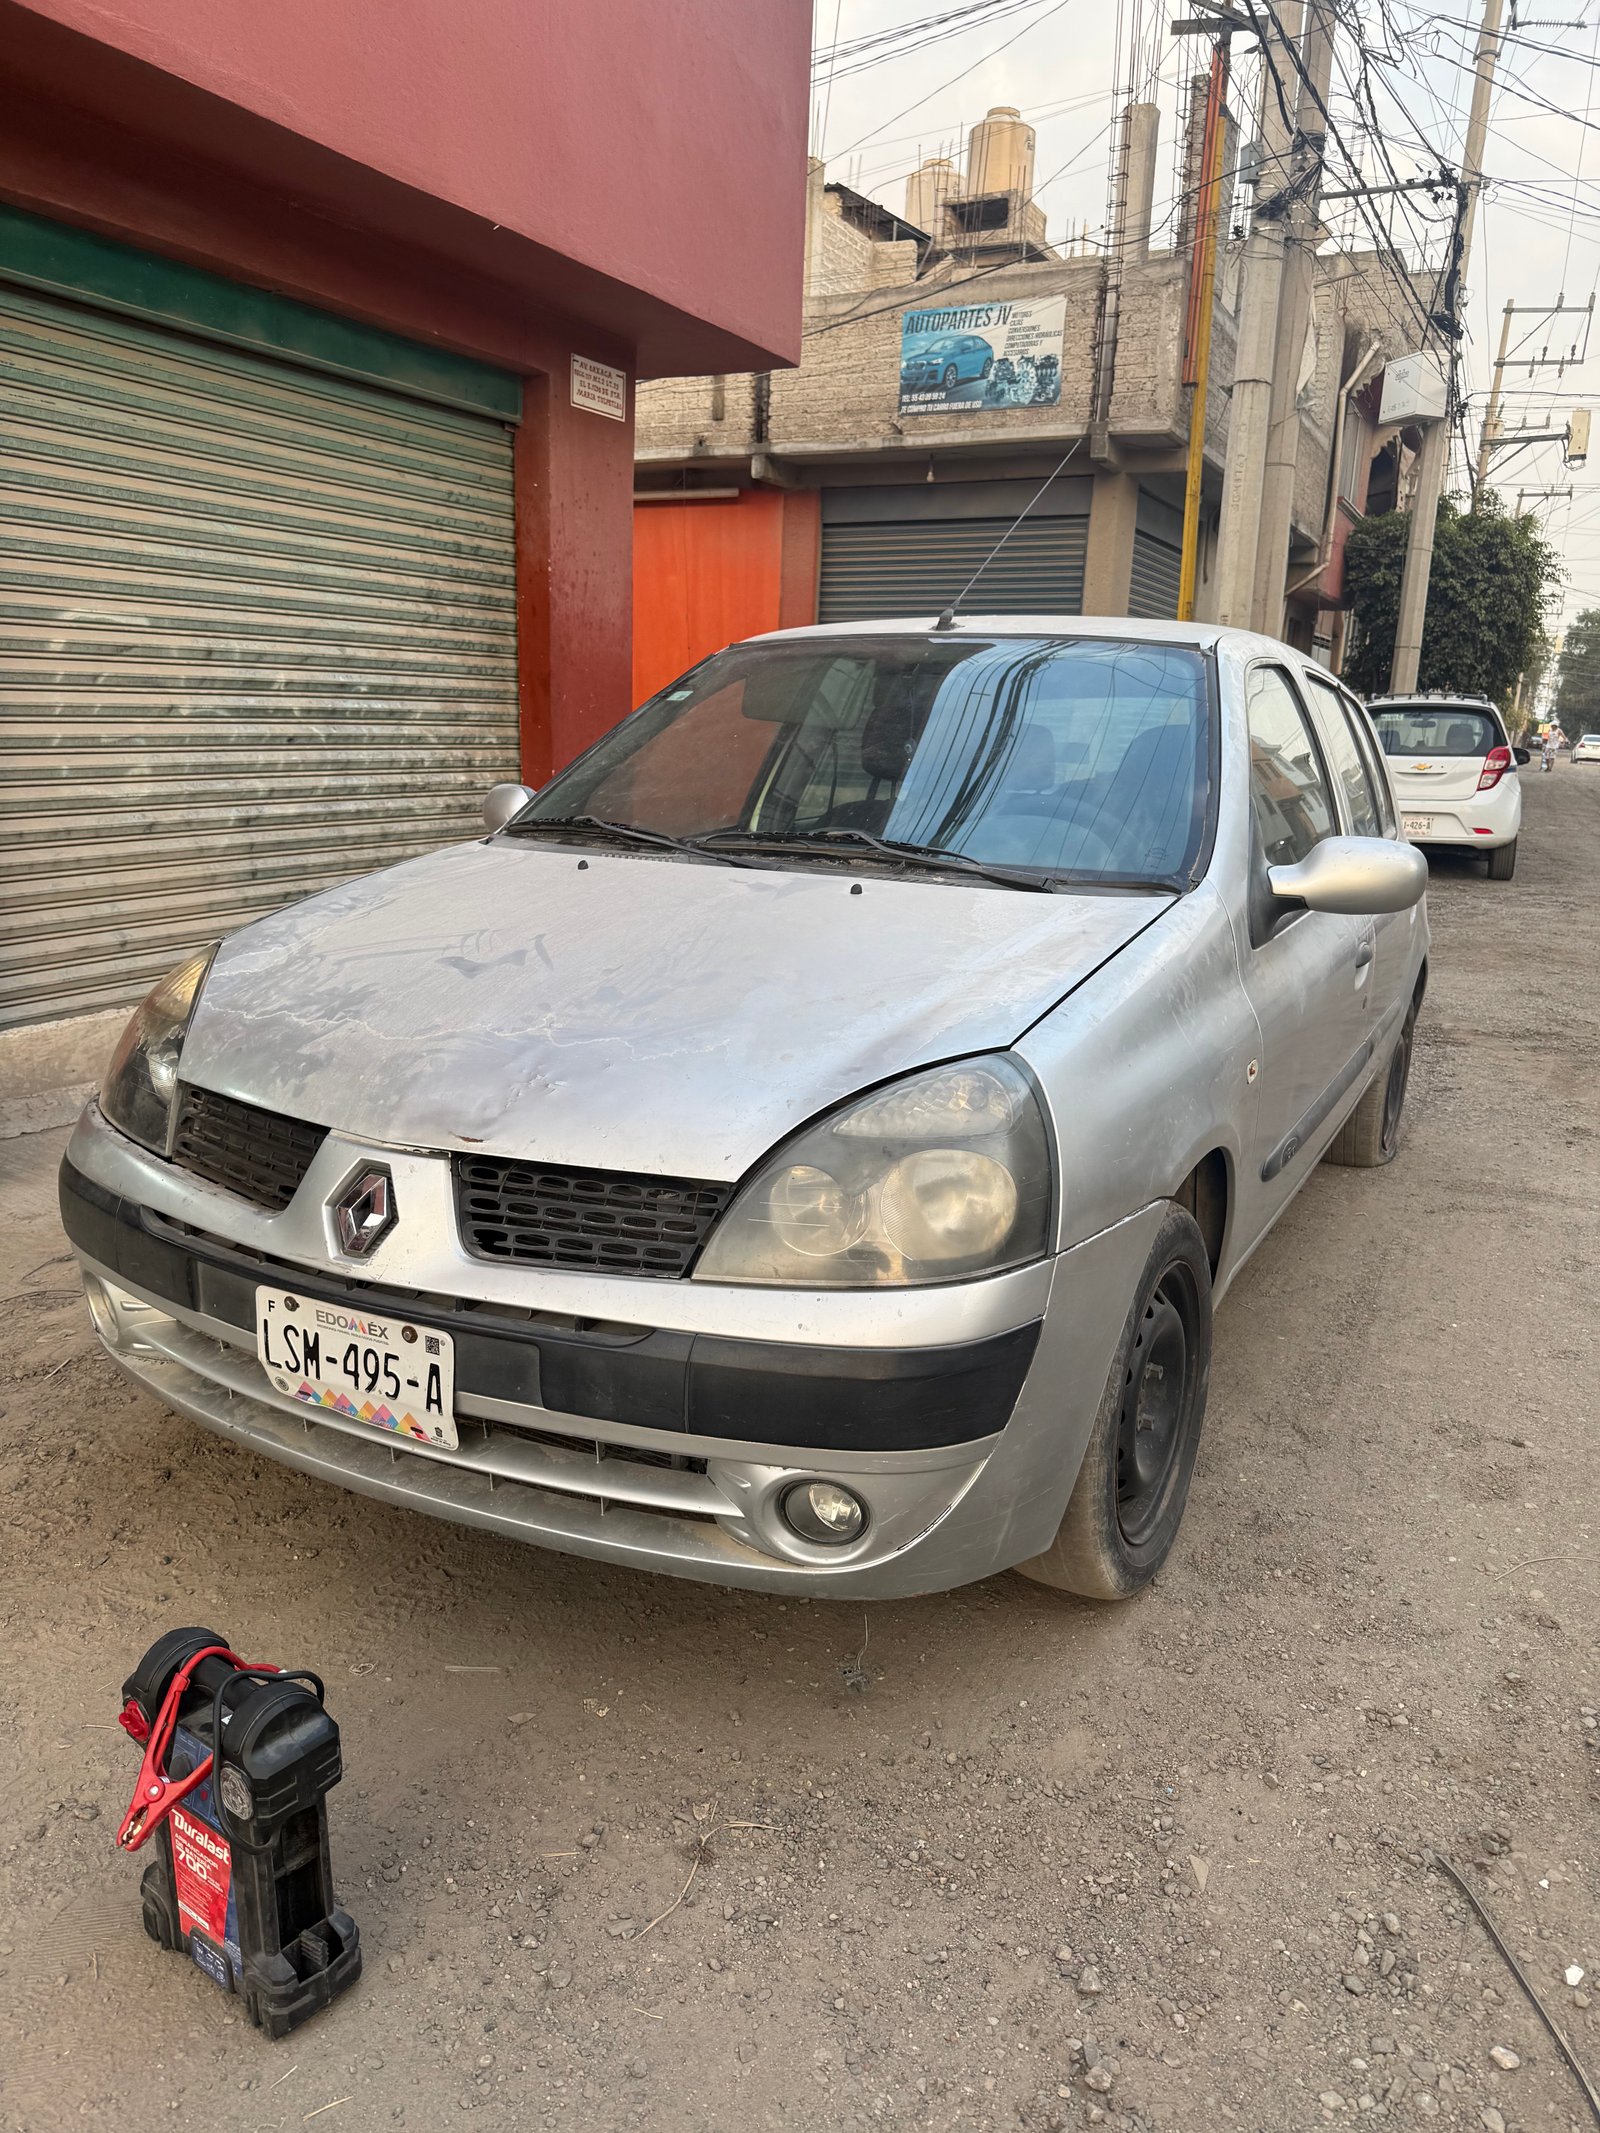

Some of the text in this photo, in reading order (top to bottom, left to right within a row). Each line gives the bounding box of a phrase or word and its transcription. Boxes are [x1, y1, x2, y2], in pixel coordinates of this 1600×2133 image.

[905, 305, 1012, 334] AUTOPARTES JV
[1007, 324, 1041, 334] CONVERSIONES
[1009, 319, 1023, 327] CAJAS
[1006, 332, 1034, 342] DIRECCIONES
[268, 1299, 276, 1312] F
[264, 1319, 444, 1416] LSM-495-A
[171, 1808, 230, 1865] Duralast
[176, 1845, 208, 1880] 700
